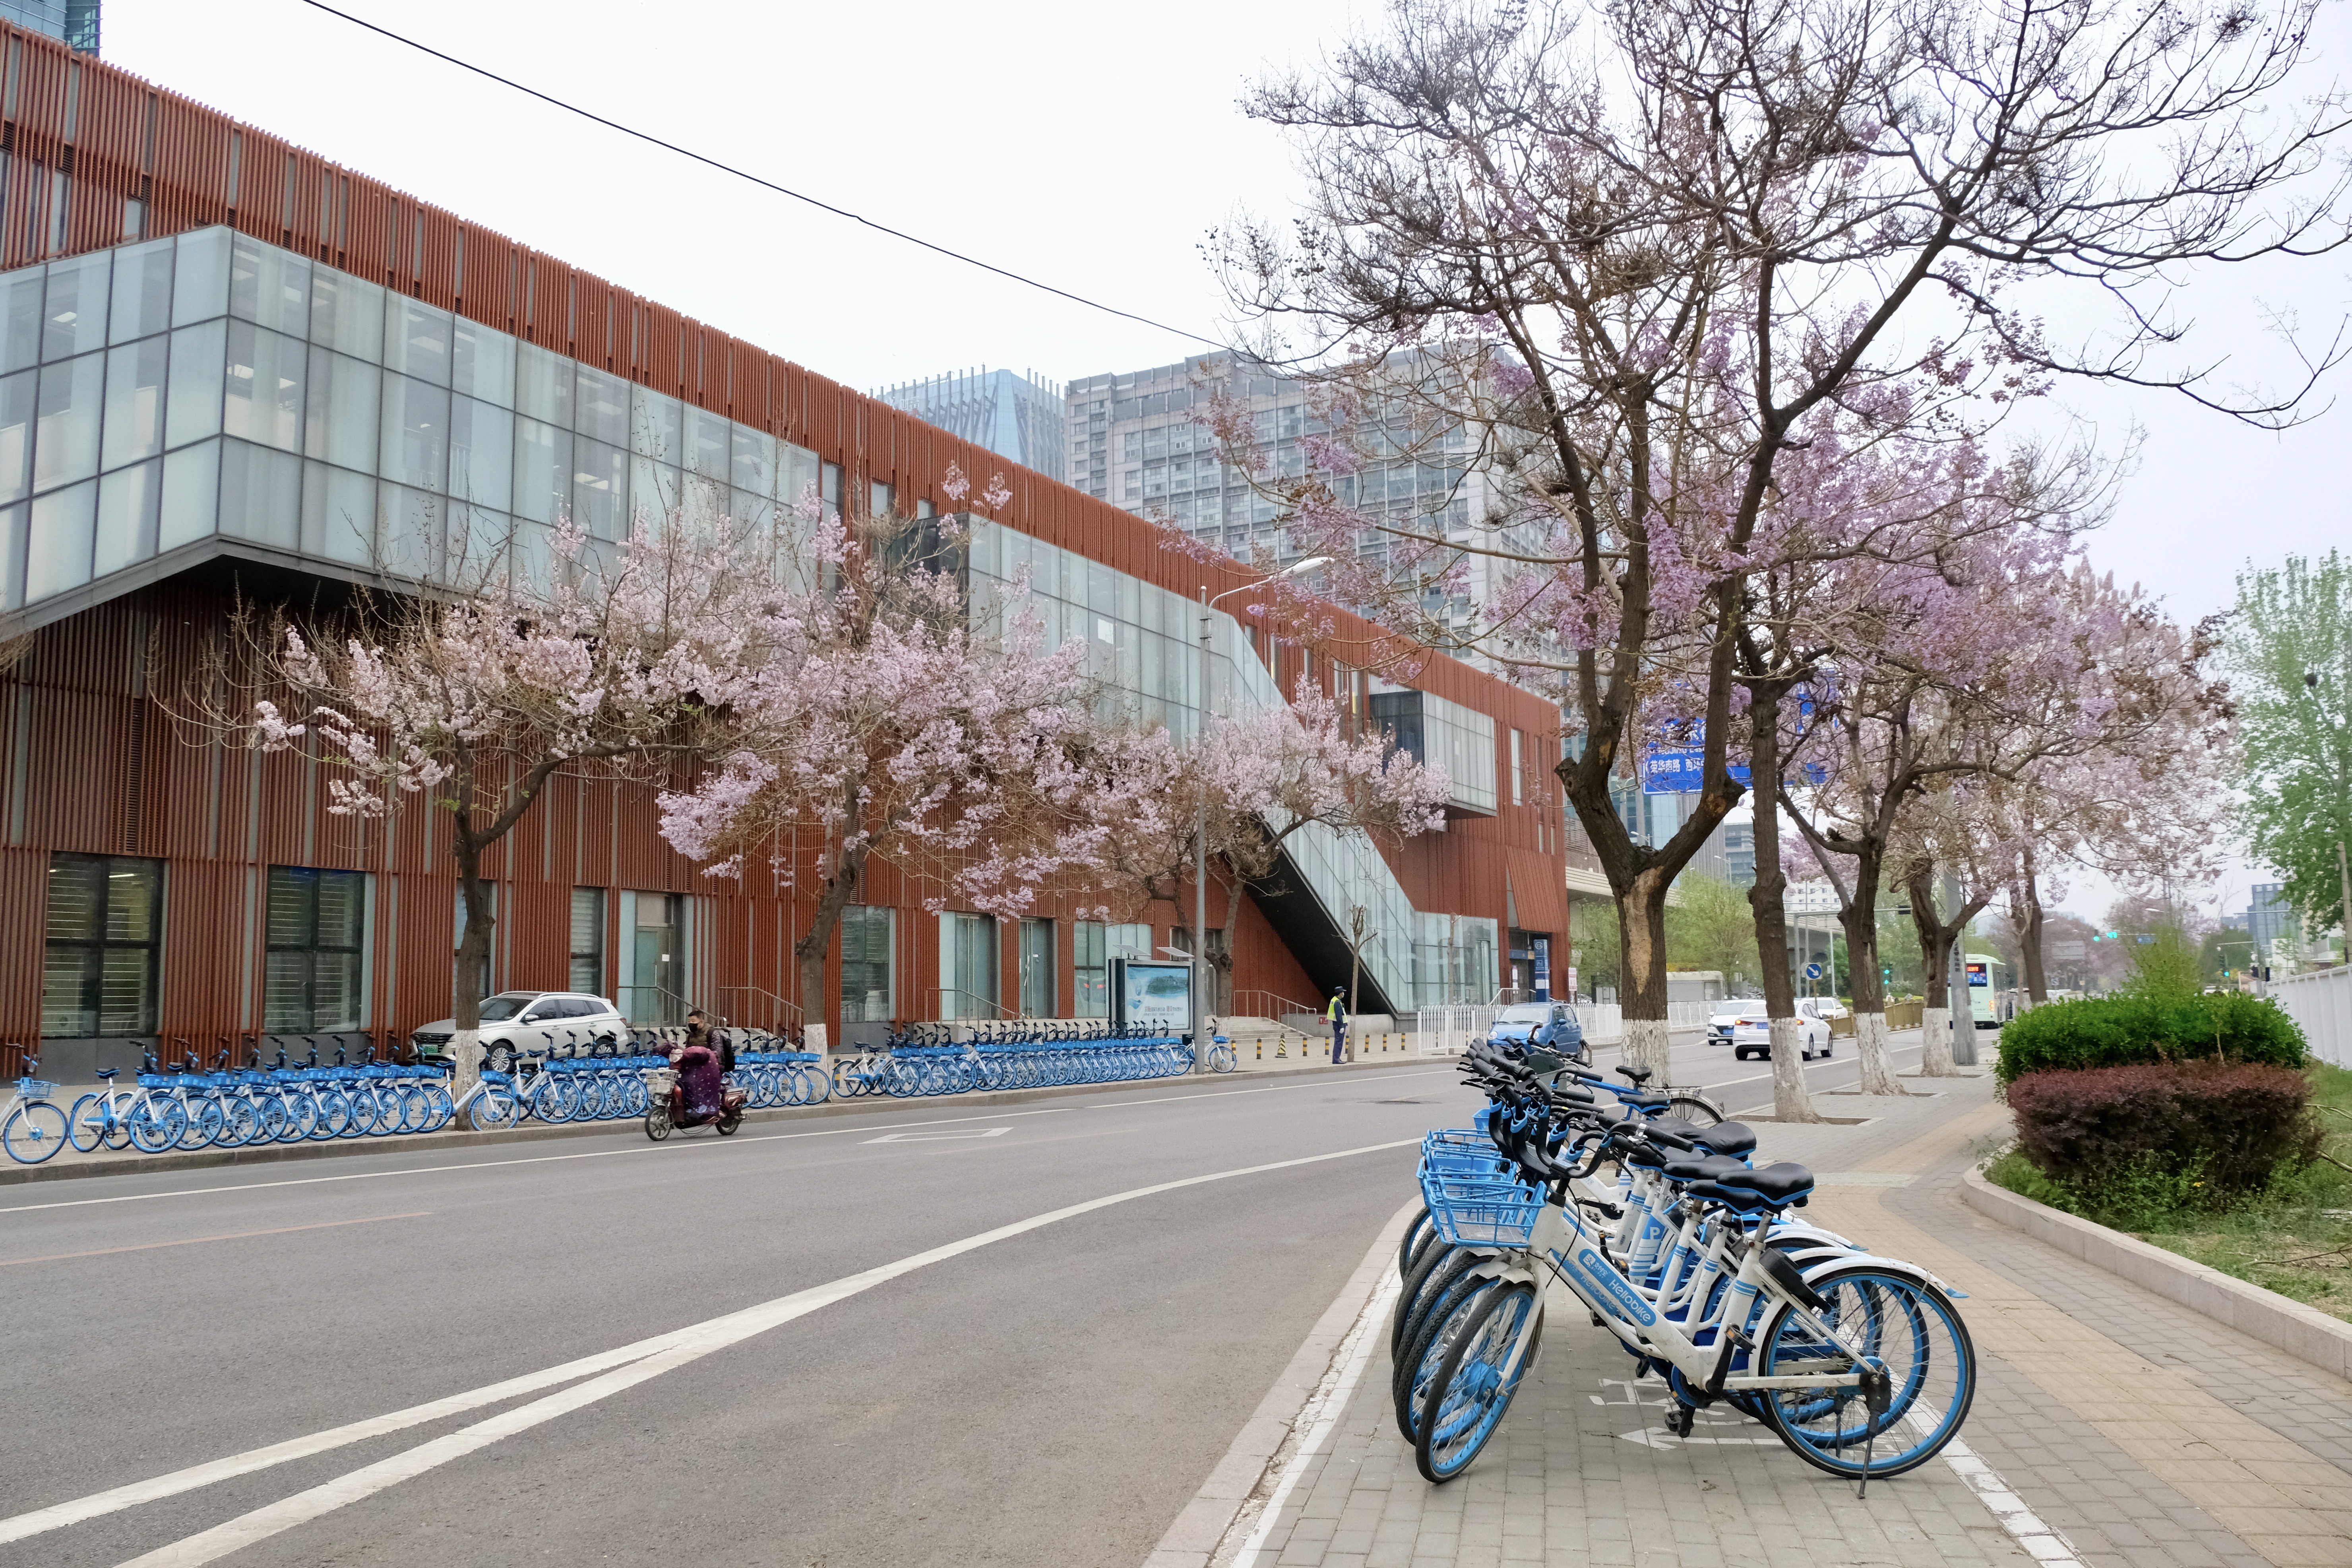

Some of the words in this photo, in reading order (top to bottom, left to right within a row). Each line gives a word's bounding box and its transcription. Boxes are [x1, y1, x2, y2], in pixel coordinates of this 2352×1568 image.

[1650, 1227, 1660, 1240] P
[1593, 1262, 1608, 1277] 支付宝
[1608, 1278, 1651, 1322] Hellobike
